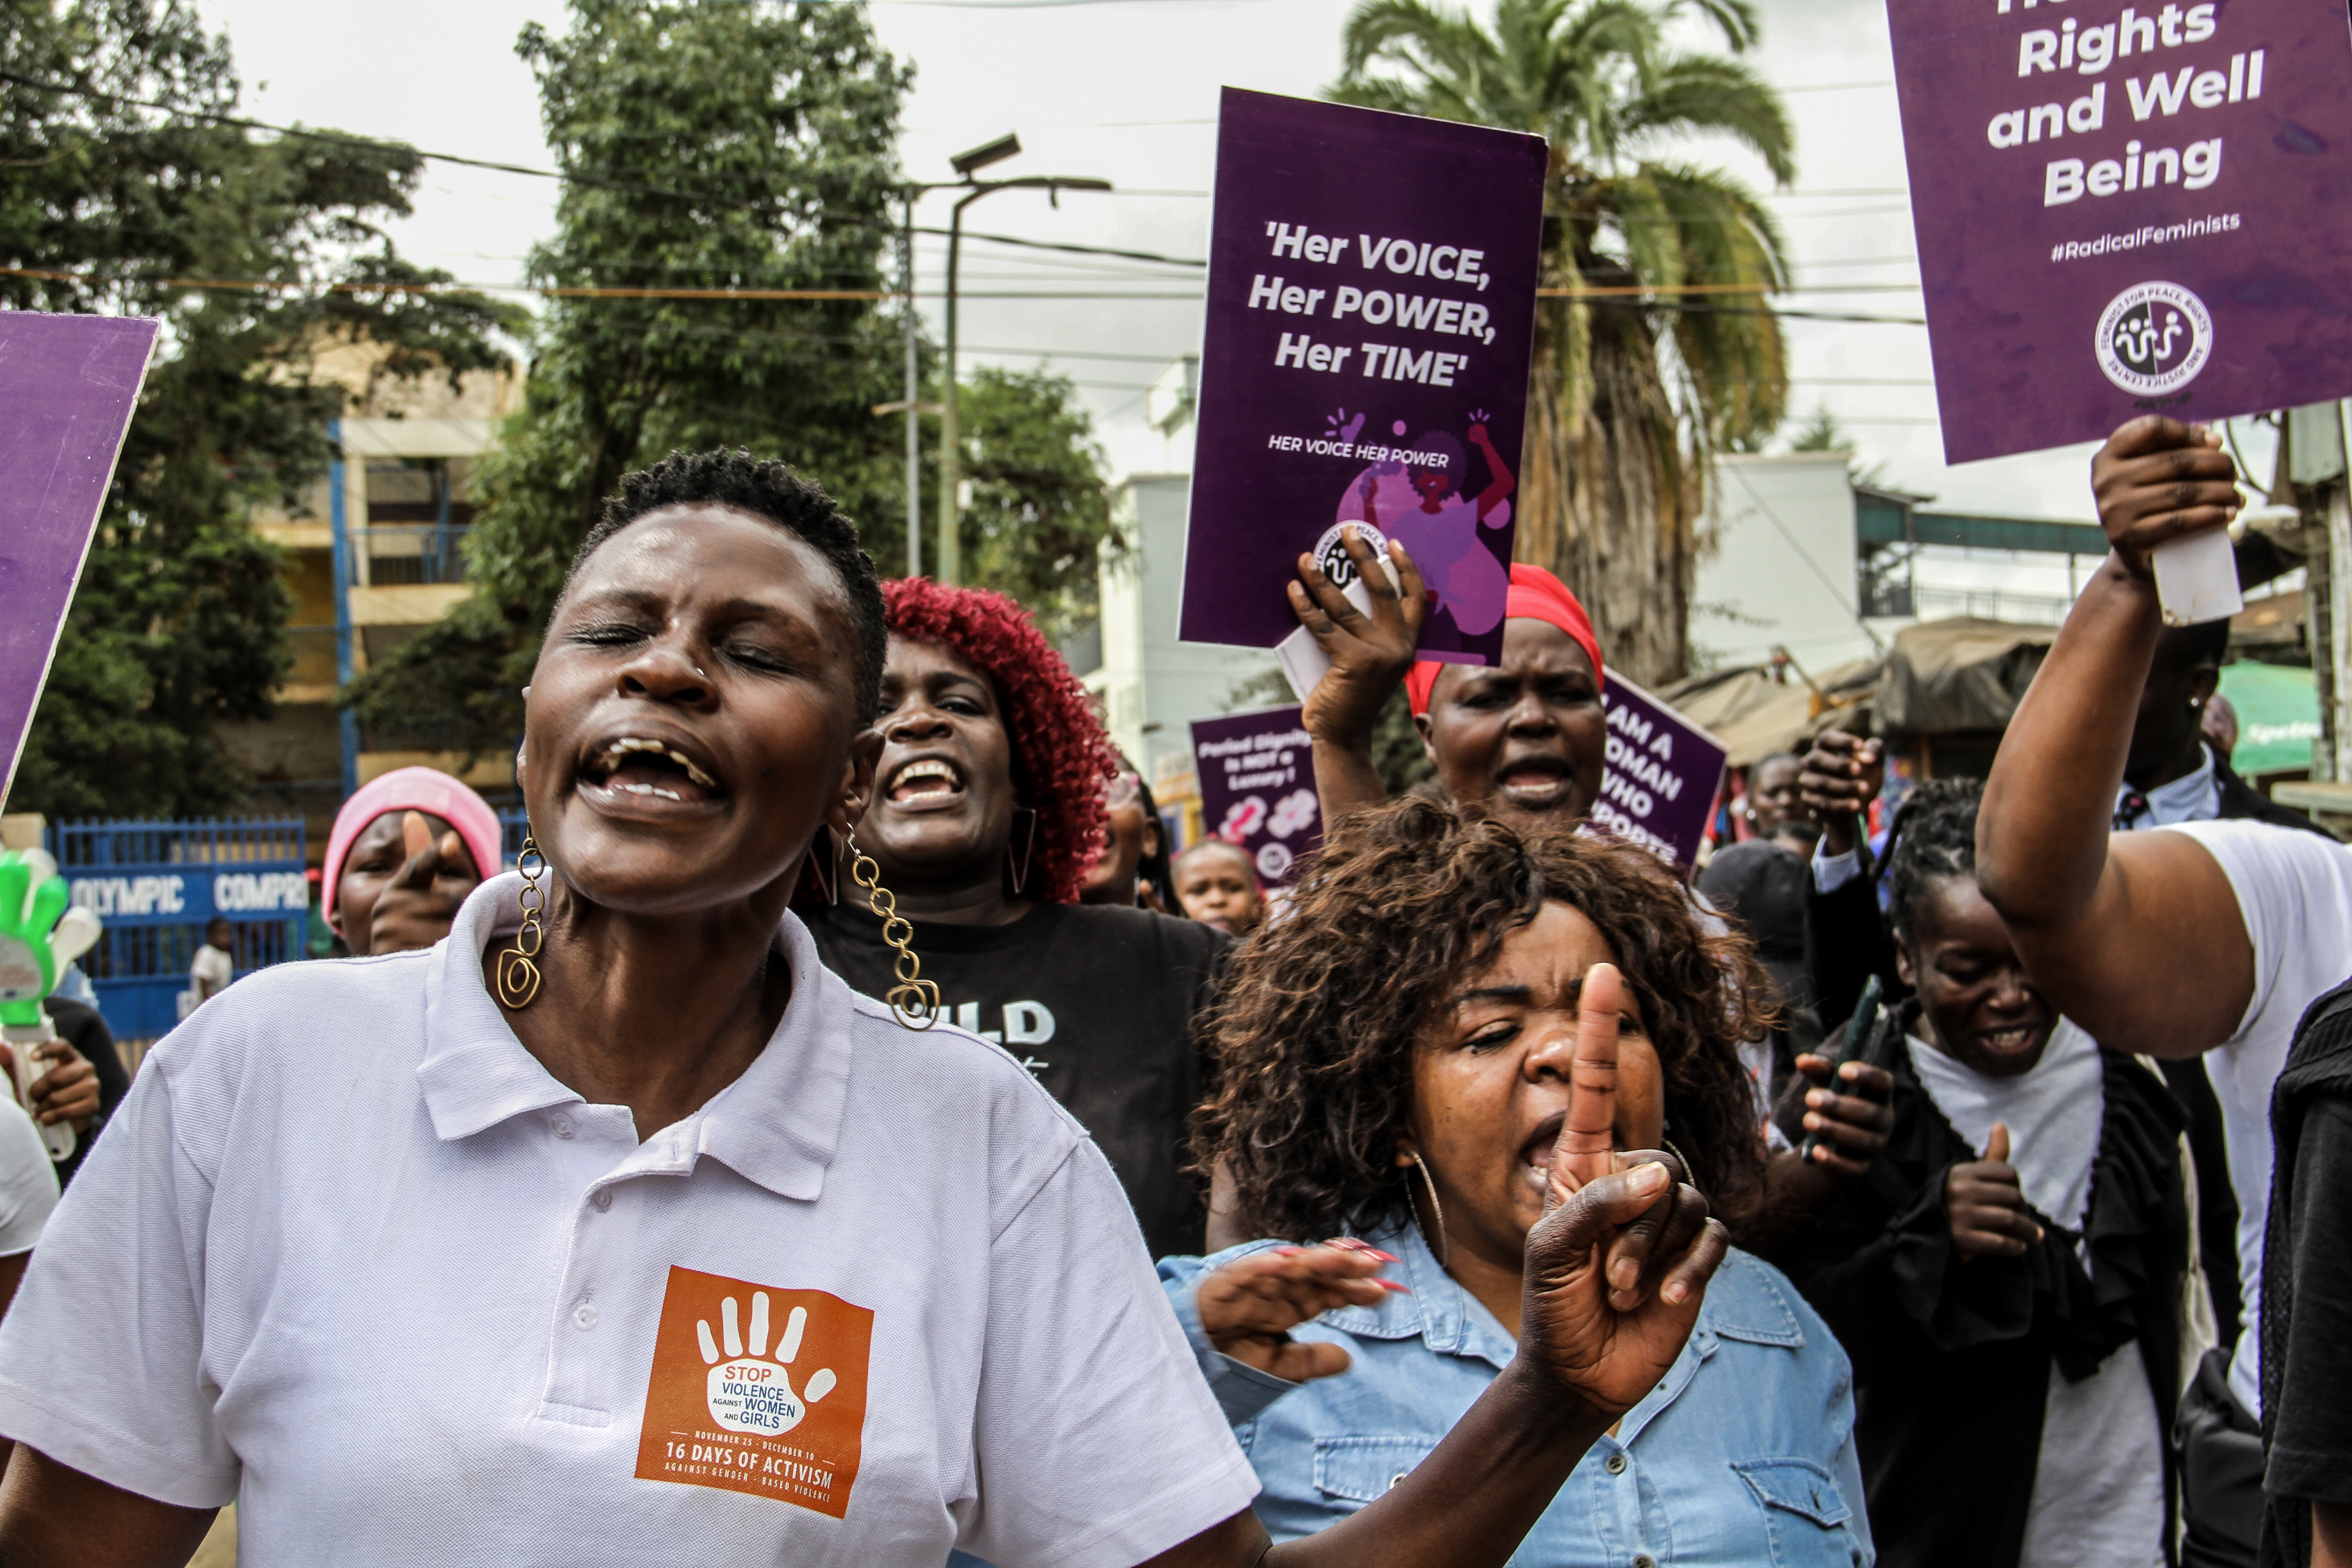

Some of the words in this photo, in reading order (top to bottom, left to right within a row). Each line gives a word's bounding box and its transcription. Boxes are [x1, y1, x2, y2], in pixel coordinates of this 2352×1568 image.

[2018, 3, 2216, 77] Rights
[1987, 81, 2106, 149] and
[2125, 49, 2264, 122] Well
[2043, 137, 2222, 207] Being
[2050, 213, 2240, 262] #RadicalFeminists
[1359, 234, 1490, 291] VOICE,
[1248, 274, 1326, 315] Her
[1332, 285, 1496, 345] POWER,
[1274, 332, 1352, 373] Her
[1361, 343, 1469, 387] TIME'
[1268, 435, 1303, 452] HER
[1305, 438, 1353, 458] VOICE
[1355, 445, 1389, 462] HER
[1390, 449, 1449, 468] POWER
[1605, 703, 1654, 745] AM
[1648, 732, 1673, 762] A
[1604, 733, 1684, 802] OMAN
[70, 874, 186, 916] OLYMPIC
[722, 1382, 784, 1401] VIOLENCE
[725, 1366, 772, 1382] STOP
[713, 1398, 742, 1406] AGAINST
[745, 1397, 795, 1418] WOMEN
[740, 1411, 779, 1429] GIRLS
[666, 1441, 686, 1459] 16
[691, 1445, 733, 1465] DAYS
[738, 1451, 759, 1470] OF
[763, 1456, 833, 1489] ACTIVISM
[695, 1431, 739, 1444] NOVEMBER
[743, 1438, 753, 1446] 25
[763, 1441, 802, 1458] DECEMBER
[806, 1452, 814, 1460] 10
[665, 1462, 707, 1475] AGAINST
[712, 1467, 749, 1481] GENDER
[762, 1476, 789, 1490] BASED
[794, 1484, 831, 1503] VIOLENCE
